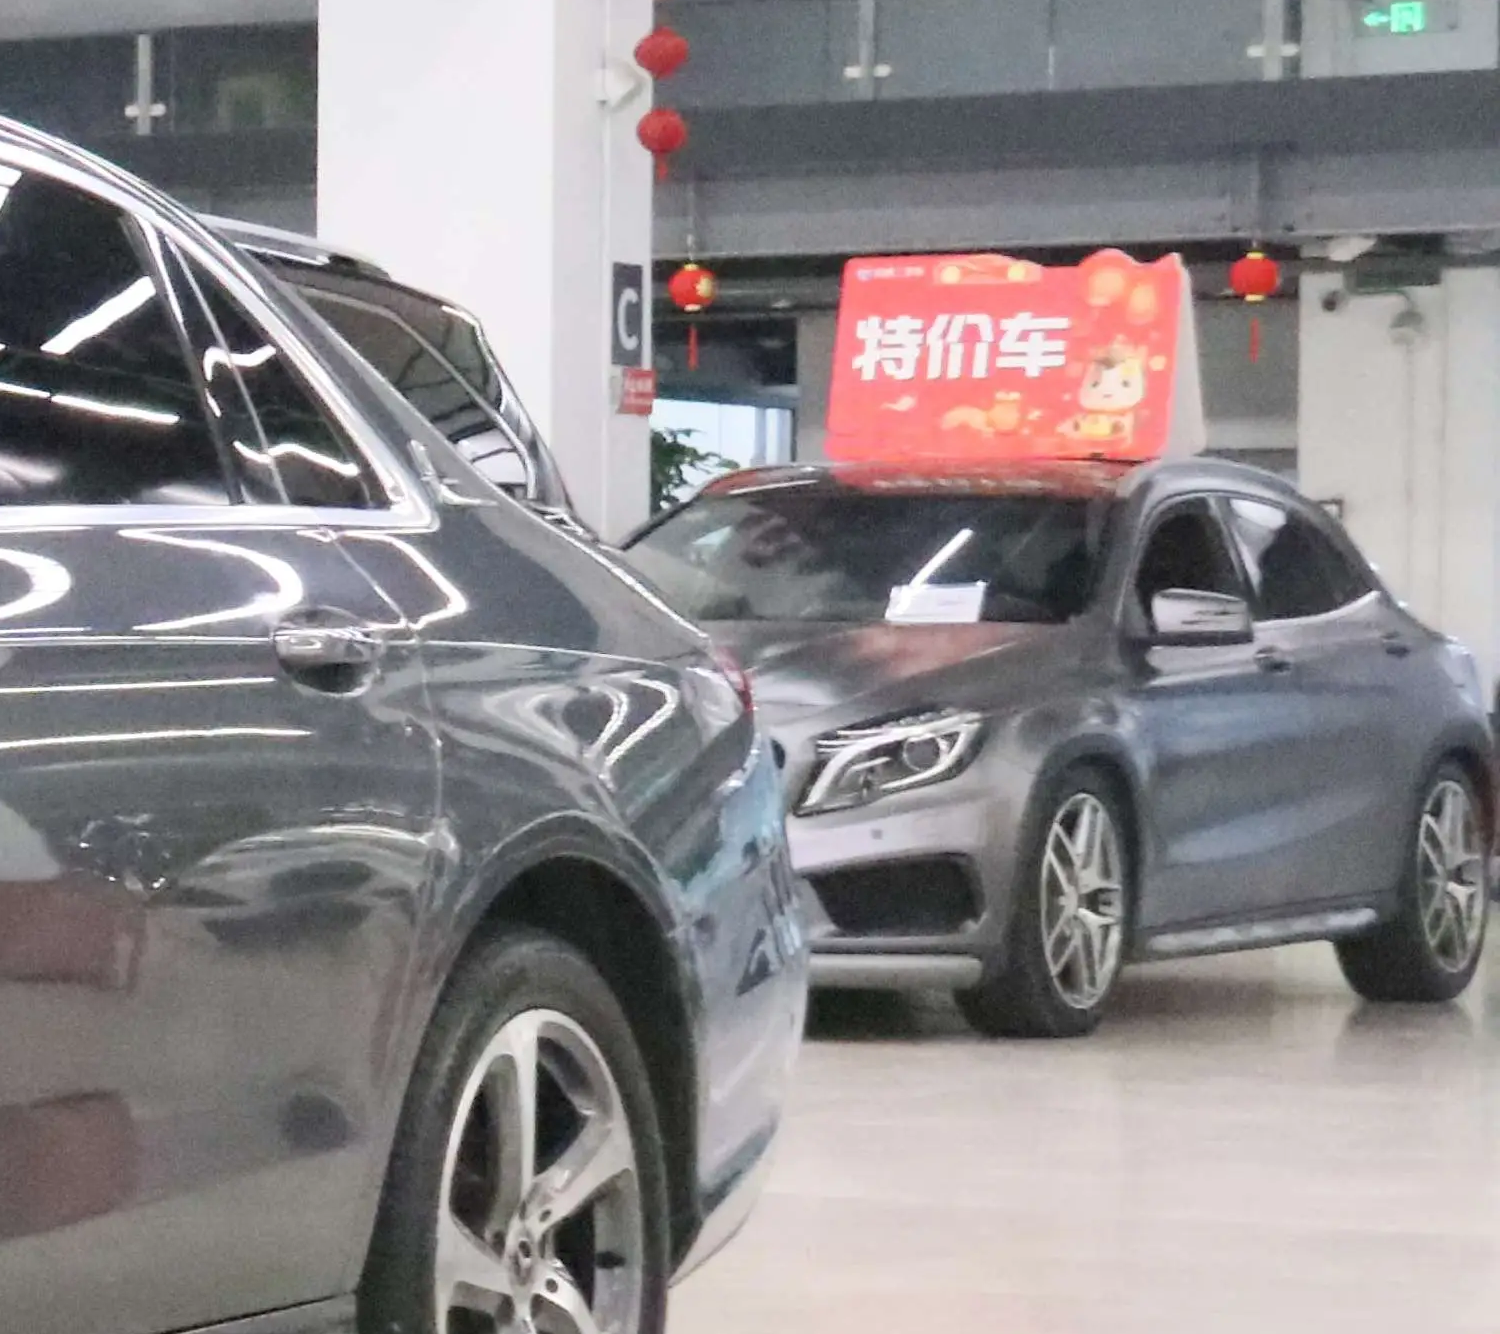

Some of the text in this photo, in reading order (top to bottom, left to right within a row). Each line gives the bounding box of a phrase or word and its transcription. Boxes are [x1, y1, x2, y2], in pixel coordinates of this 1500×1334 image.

[617, 287, 639, 351] C
[851, 311, 1072, 381] 特价车
